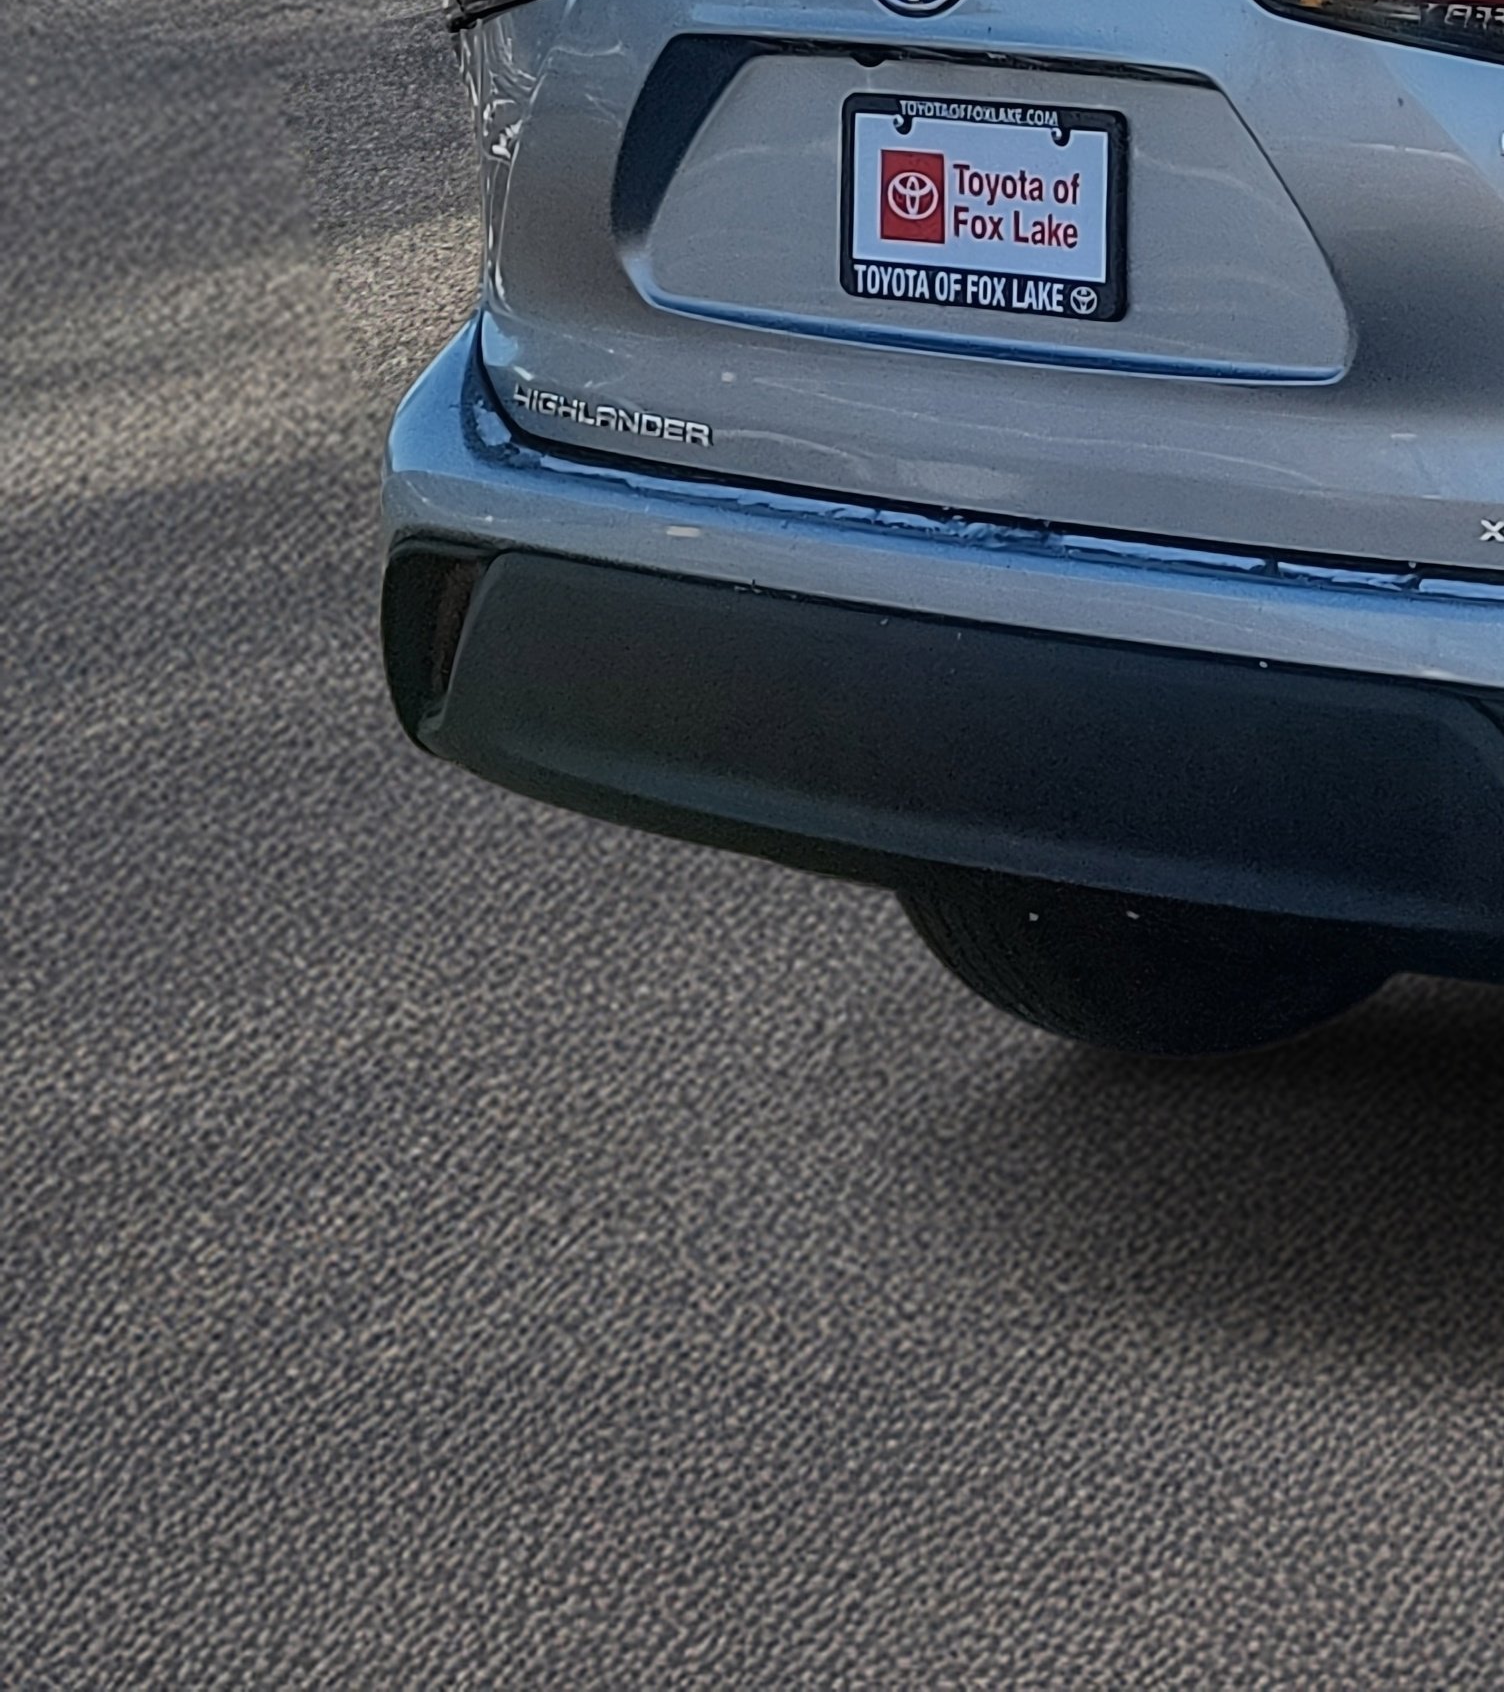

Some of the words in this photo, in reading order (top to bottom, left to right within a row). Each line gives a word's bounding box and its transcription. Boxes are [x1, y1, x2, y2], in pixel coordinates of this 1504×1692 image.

[953, 163, 1044, 205] Toyota
[1053, 172, 1080, 205] of
[953, 205, 1004, 241] Fox
[1013, 210, 1079, 249] Lake
[854, 264, 930, 299] TOYOTA
[935, 272, 962, 302] OF
[966, 275, 1006, 307] FOX
[1012, 278, 1065, 312] LAKE
[513, 383, 713, 448] HIGHLANDER
